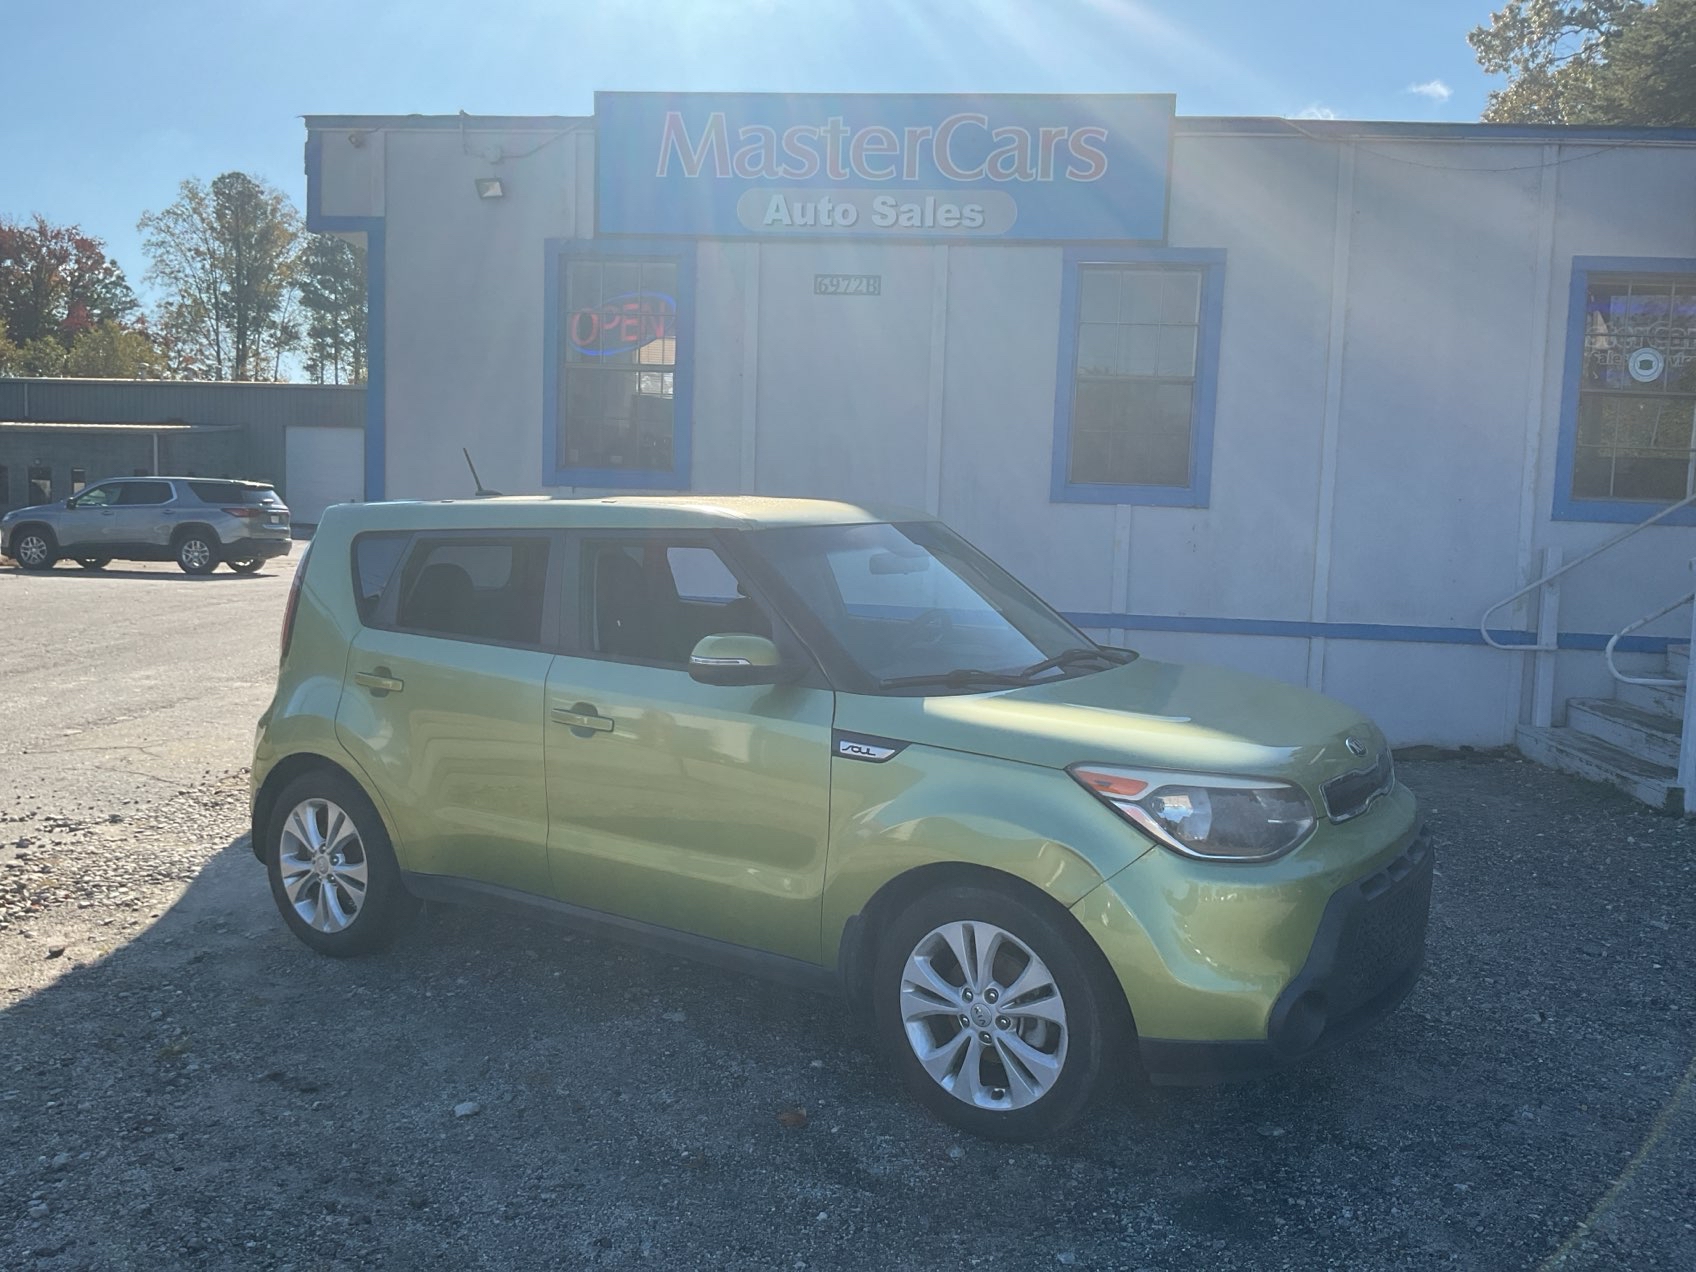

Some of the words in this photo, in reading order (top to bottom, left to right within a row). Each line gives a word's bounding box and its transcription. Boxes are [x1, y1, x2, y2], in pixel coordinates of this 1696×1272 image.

[656, 111, 1109, 182] MasterCars
[763, 194, 858, 228] Auto
[872, 196, 985, 229] Sales
[570, 301, 666, 346] OPEN
